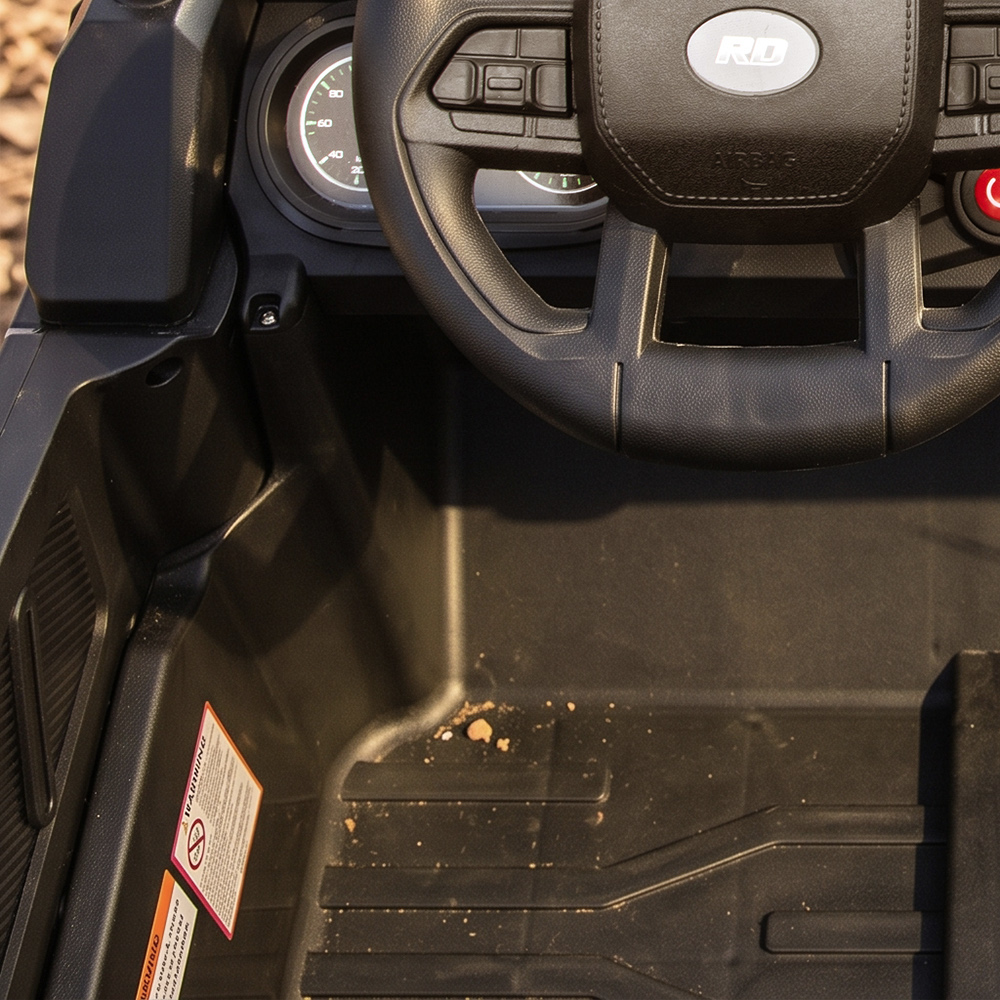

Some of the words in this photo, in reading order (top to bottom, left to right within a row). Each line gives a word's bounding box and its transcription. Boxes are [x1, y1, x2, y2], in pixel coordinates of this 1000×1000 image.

[714, 35, 789, 67] RD
[328, 88, 344, 99] 80
[317, 118, 333, 128] 60
[328, 149, 344, 160] 40
